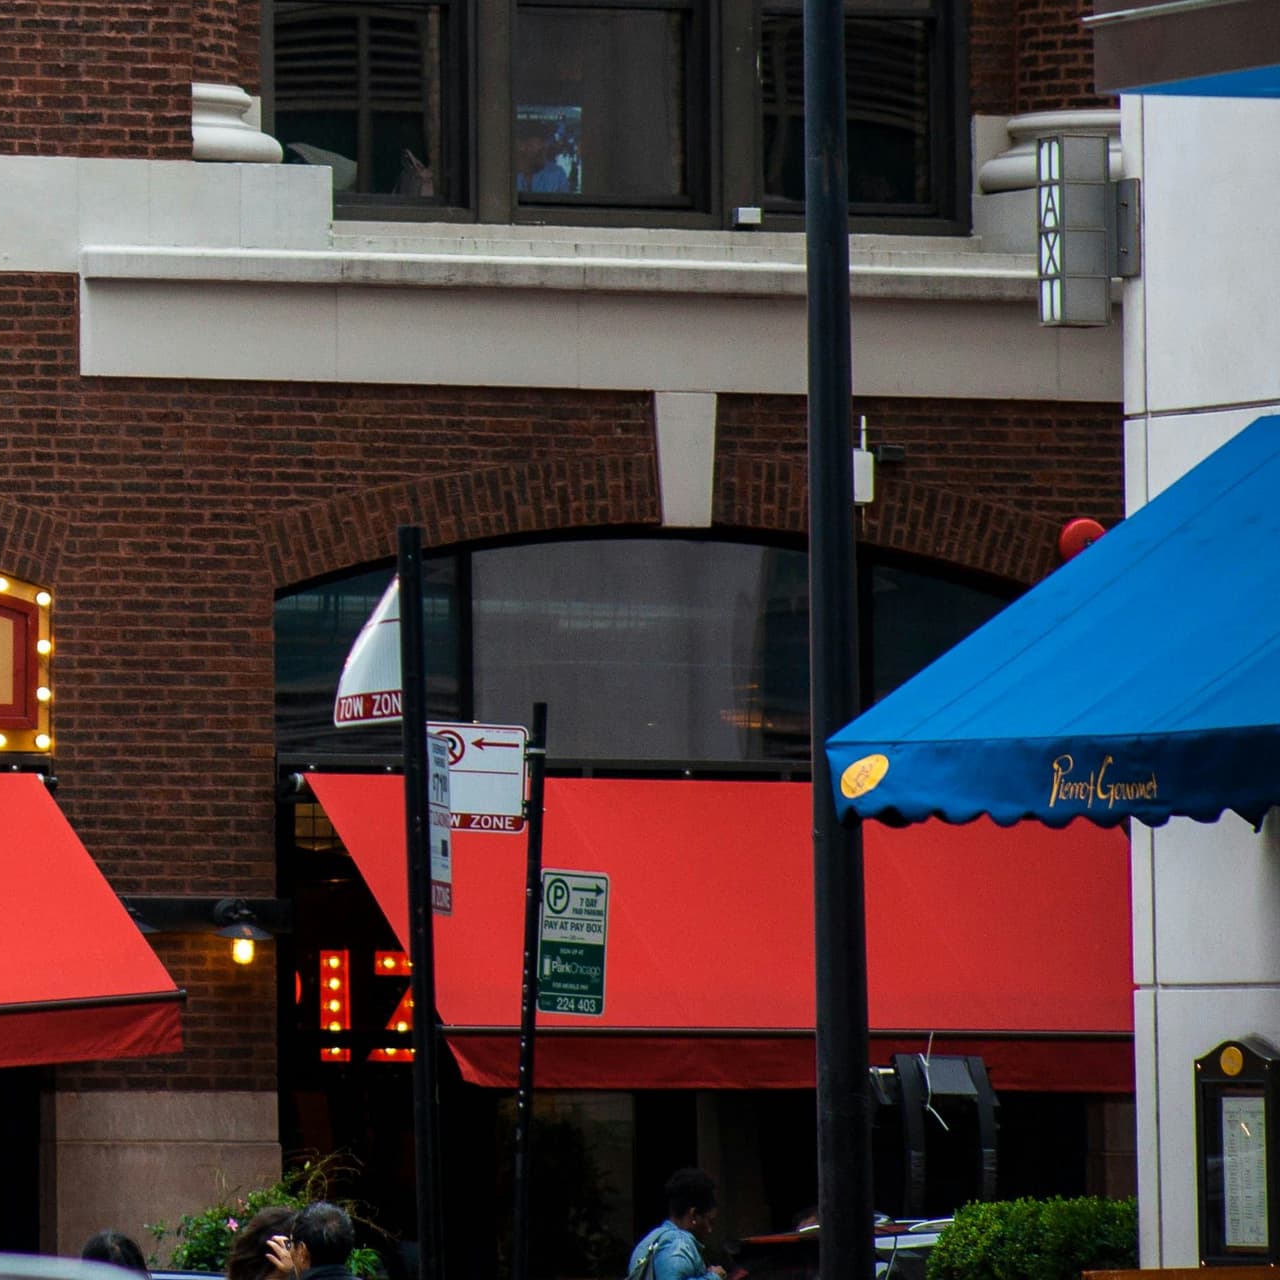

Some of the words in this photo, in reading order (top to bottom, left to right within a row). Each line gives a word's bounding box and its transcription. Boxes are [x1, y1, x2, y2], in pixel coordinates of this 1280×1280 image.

[1039, 137, 1062, 323] TAXI
[339, 695, 365, 721] TOW
[371, 691, 403, 717] ZON
[1048, 753, 1095, 809] Pierrot
[1096, 754, 1158, 809] Gourmet
[469, 814, 515, 830] ZONE
[585, 898, 598, 908] DAY
[544, 919, 558, 930] PAY
[559, 921, 569, 931] AT
[570, 922, 586, 933] PAY
[586, 923, 603, 934] BOX
[551, 959, 601, 978] ParkChicago
[556, 997, 575, 1011] 224
[577, 998, 597, 1013] 403
